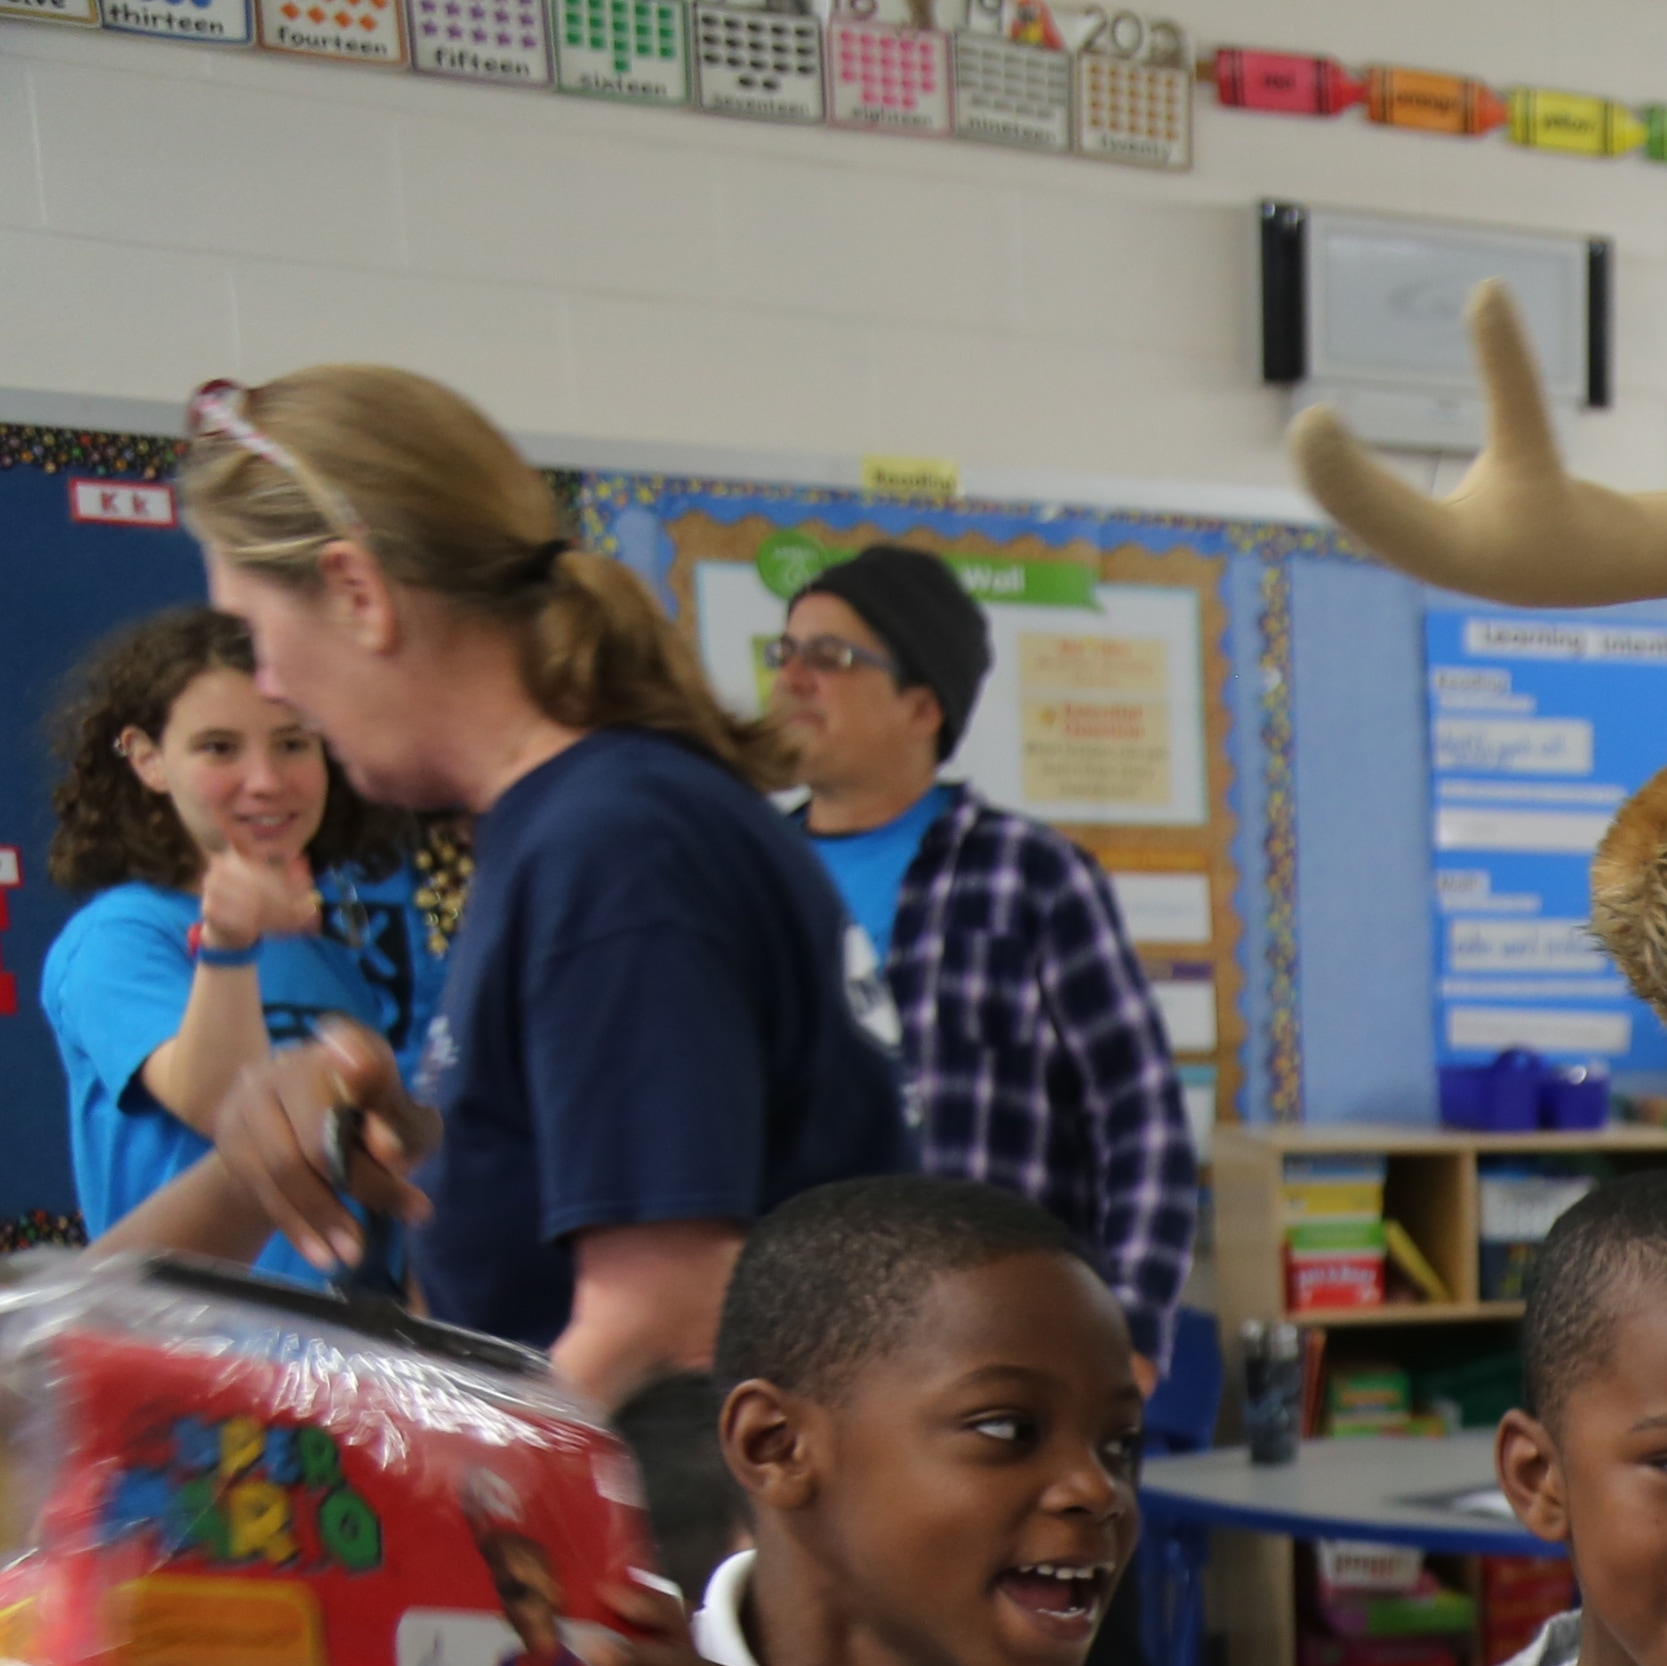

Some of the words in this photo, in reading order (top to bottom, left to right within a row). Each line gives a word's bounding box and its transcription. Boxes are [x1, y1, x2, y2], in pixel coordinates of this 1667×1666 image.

[109, 6, 225, 36] thirteen
[277, 26, 388, 56] fourteen
[435, 48, 530, 76] fifteen
[579, 71, 668, 97] sixteen
